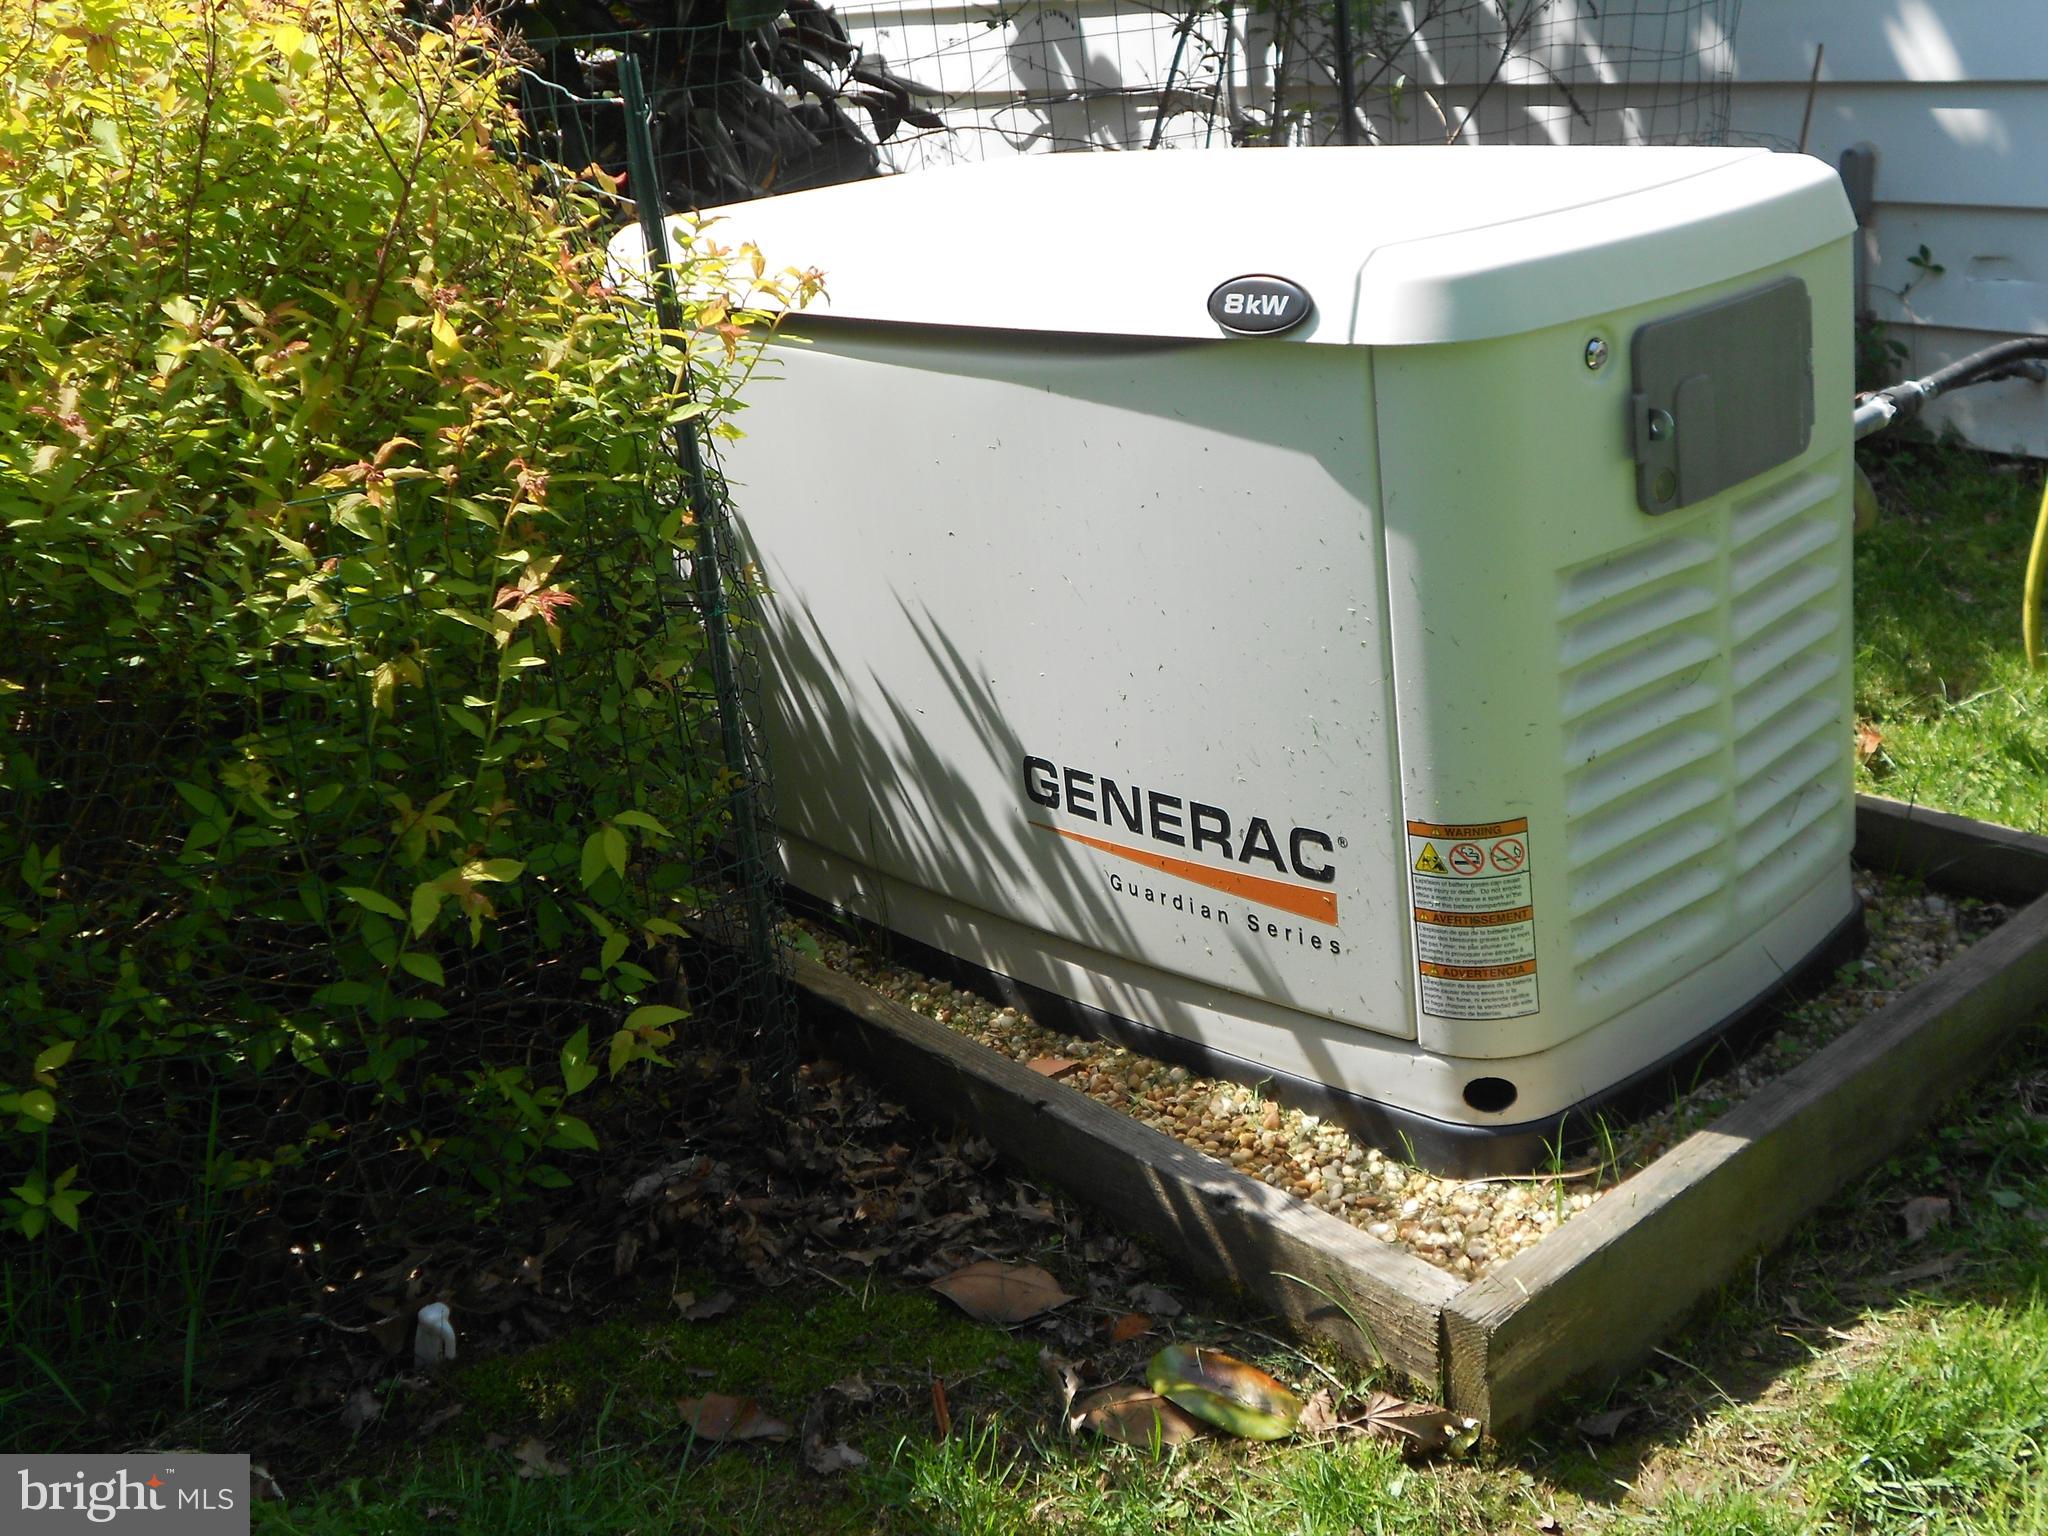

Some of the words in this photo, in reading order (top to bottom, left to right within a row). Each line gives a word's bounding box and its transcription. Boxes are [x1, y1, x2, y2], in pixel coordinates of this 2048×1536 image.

[1224, 293, 1289, 316] 8kW
[1445, 826, 1501, 837] WARNING
[1110, 874, 1228, 925] Guardian
[1248, 914, 1340, 954] Series
[1433, 910, 1527, 923] AVERTISSEMENT
[1443, 965, 1525, 977] ADVERTENCIA
